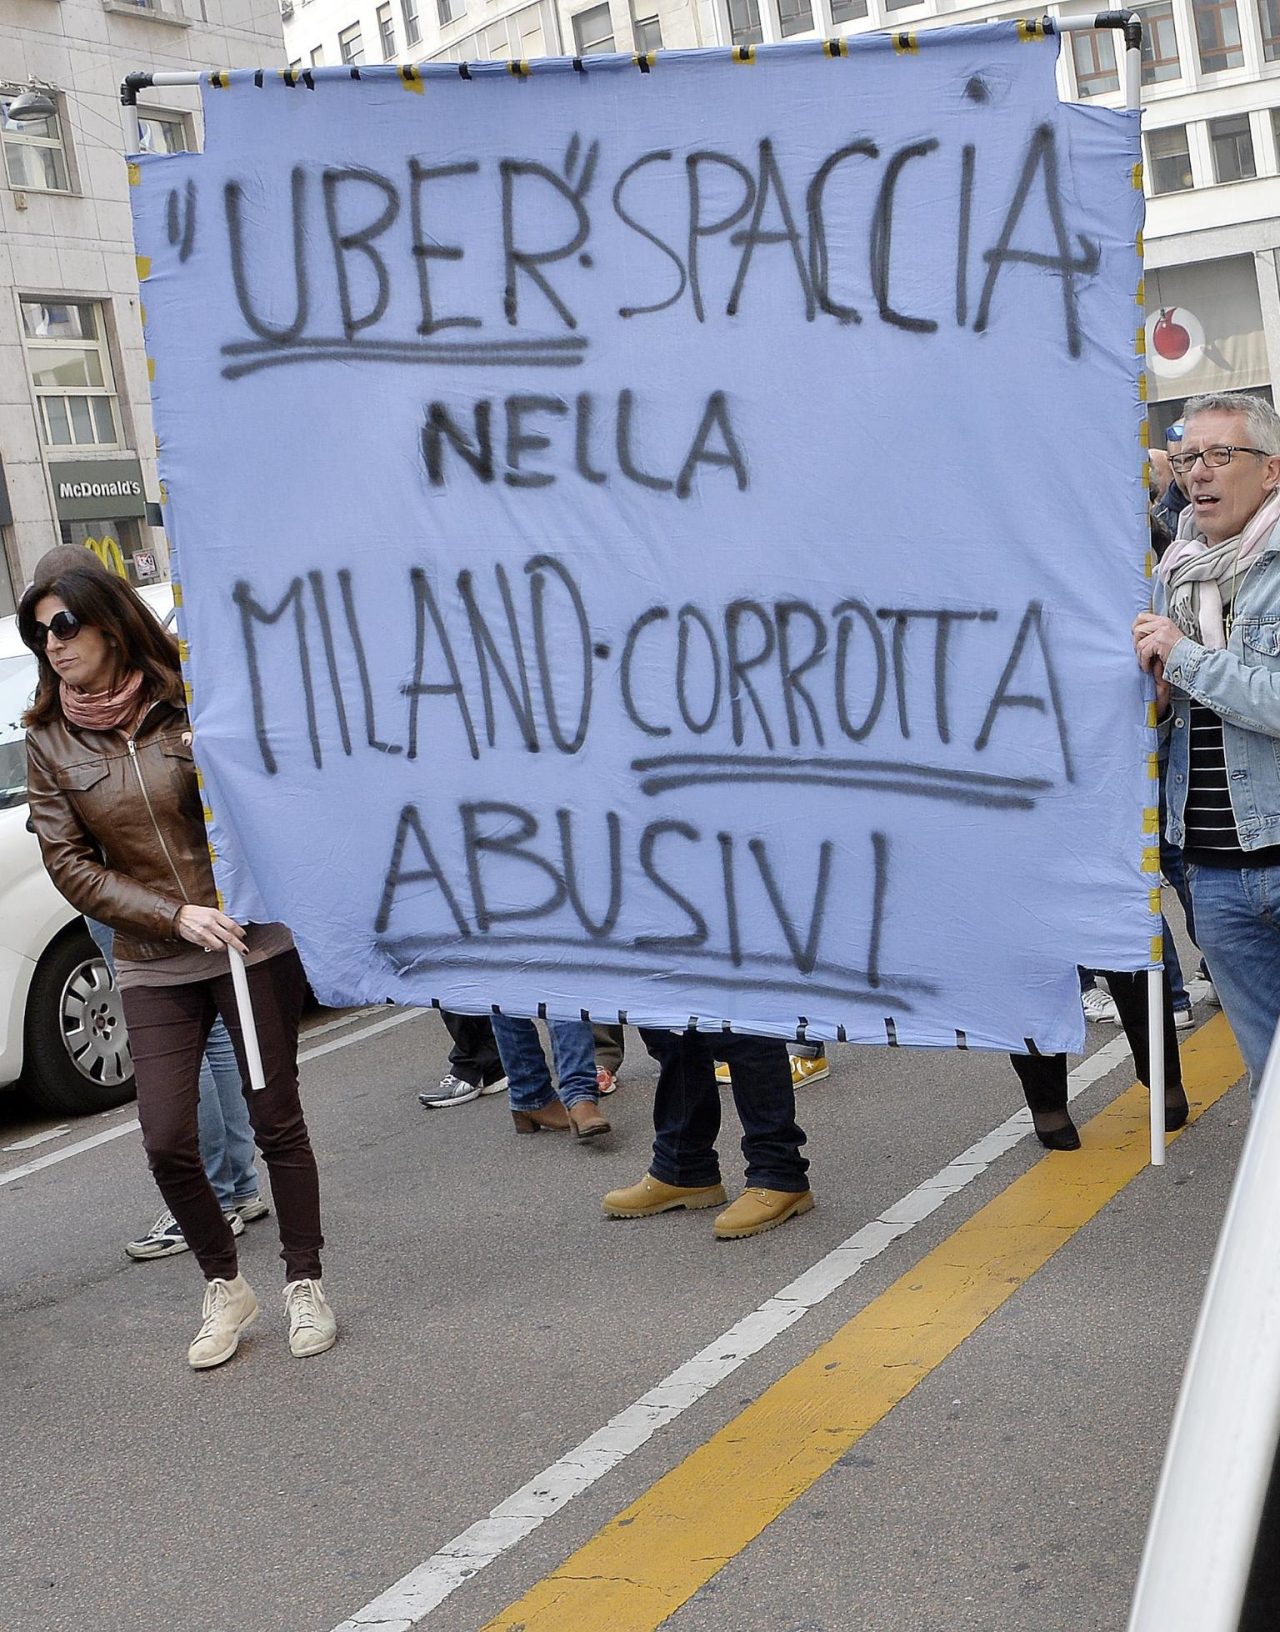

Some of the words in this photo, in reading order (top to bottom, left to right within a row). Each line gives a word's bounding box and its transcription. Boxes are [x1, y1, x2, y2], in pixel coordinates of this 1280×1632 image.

[612, 121, 1100, 358] SPACCIA
[60, 480, 141, 498] McDonald's
[420, 388, 749, 499] NELLA
[619, 598, 1075, 783] CORROTTA
[374, 799, 887, 988] ABUSIVI
